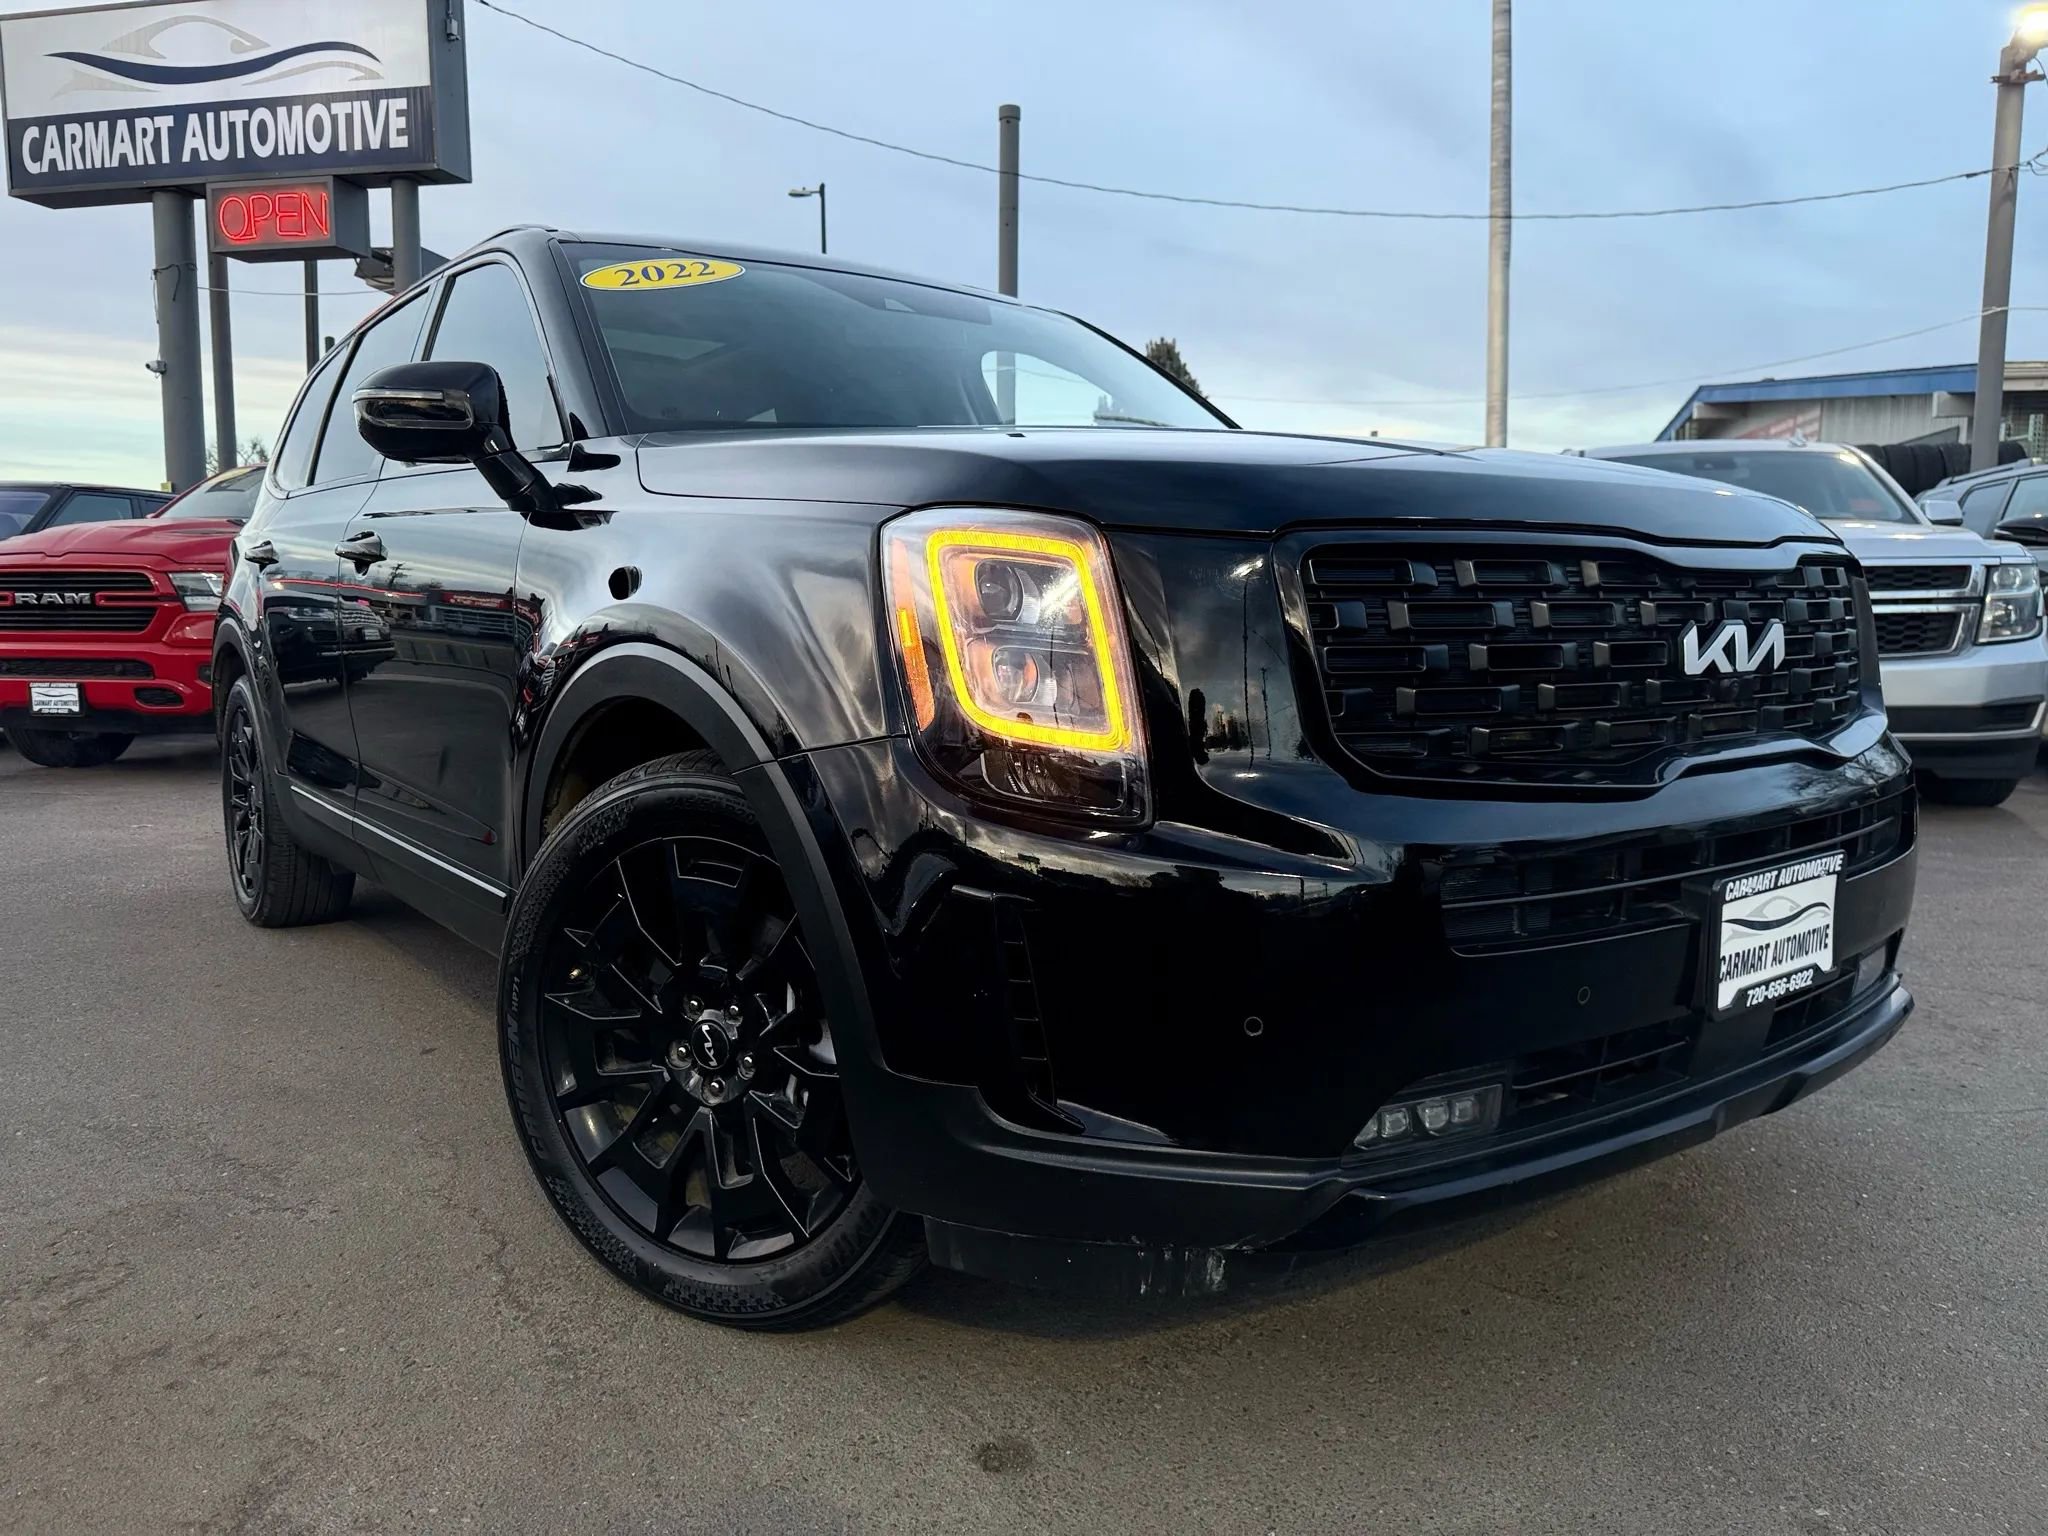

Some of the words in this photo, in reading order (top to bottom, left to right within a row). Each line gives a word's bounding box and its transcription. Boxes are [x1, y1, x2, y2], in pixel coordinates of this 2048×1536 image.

[22, 114, 175, 175] CARMART
[181, 97, 409, 163] AUTOMOTIVE
[219, 192, 329, 240] OPEN
[614, 261, 716, 287] 2022
[15, 592, 91, 605] RAM
[1682, 619, 1786, 675] KIA
[1725, 870, 1779, 901] CARMART
[1777, 854, 1844, 887] AUTOMOTIVE
[1719, 942, 1771, 983] CARMART
[1770, 923, 1830, 968] AUTOMOTIVE
[1746, 968, 1814, 1007] 720-656-6922
